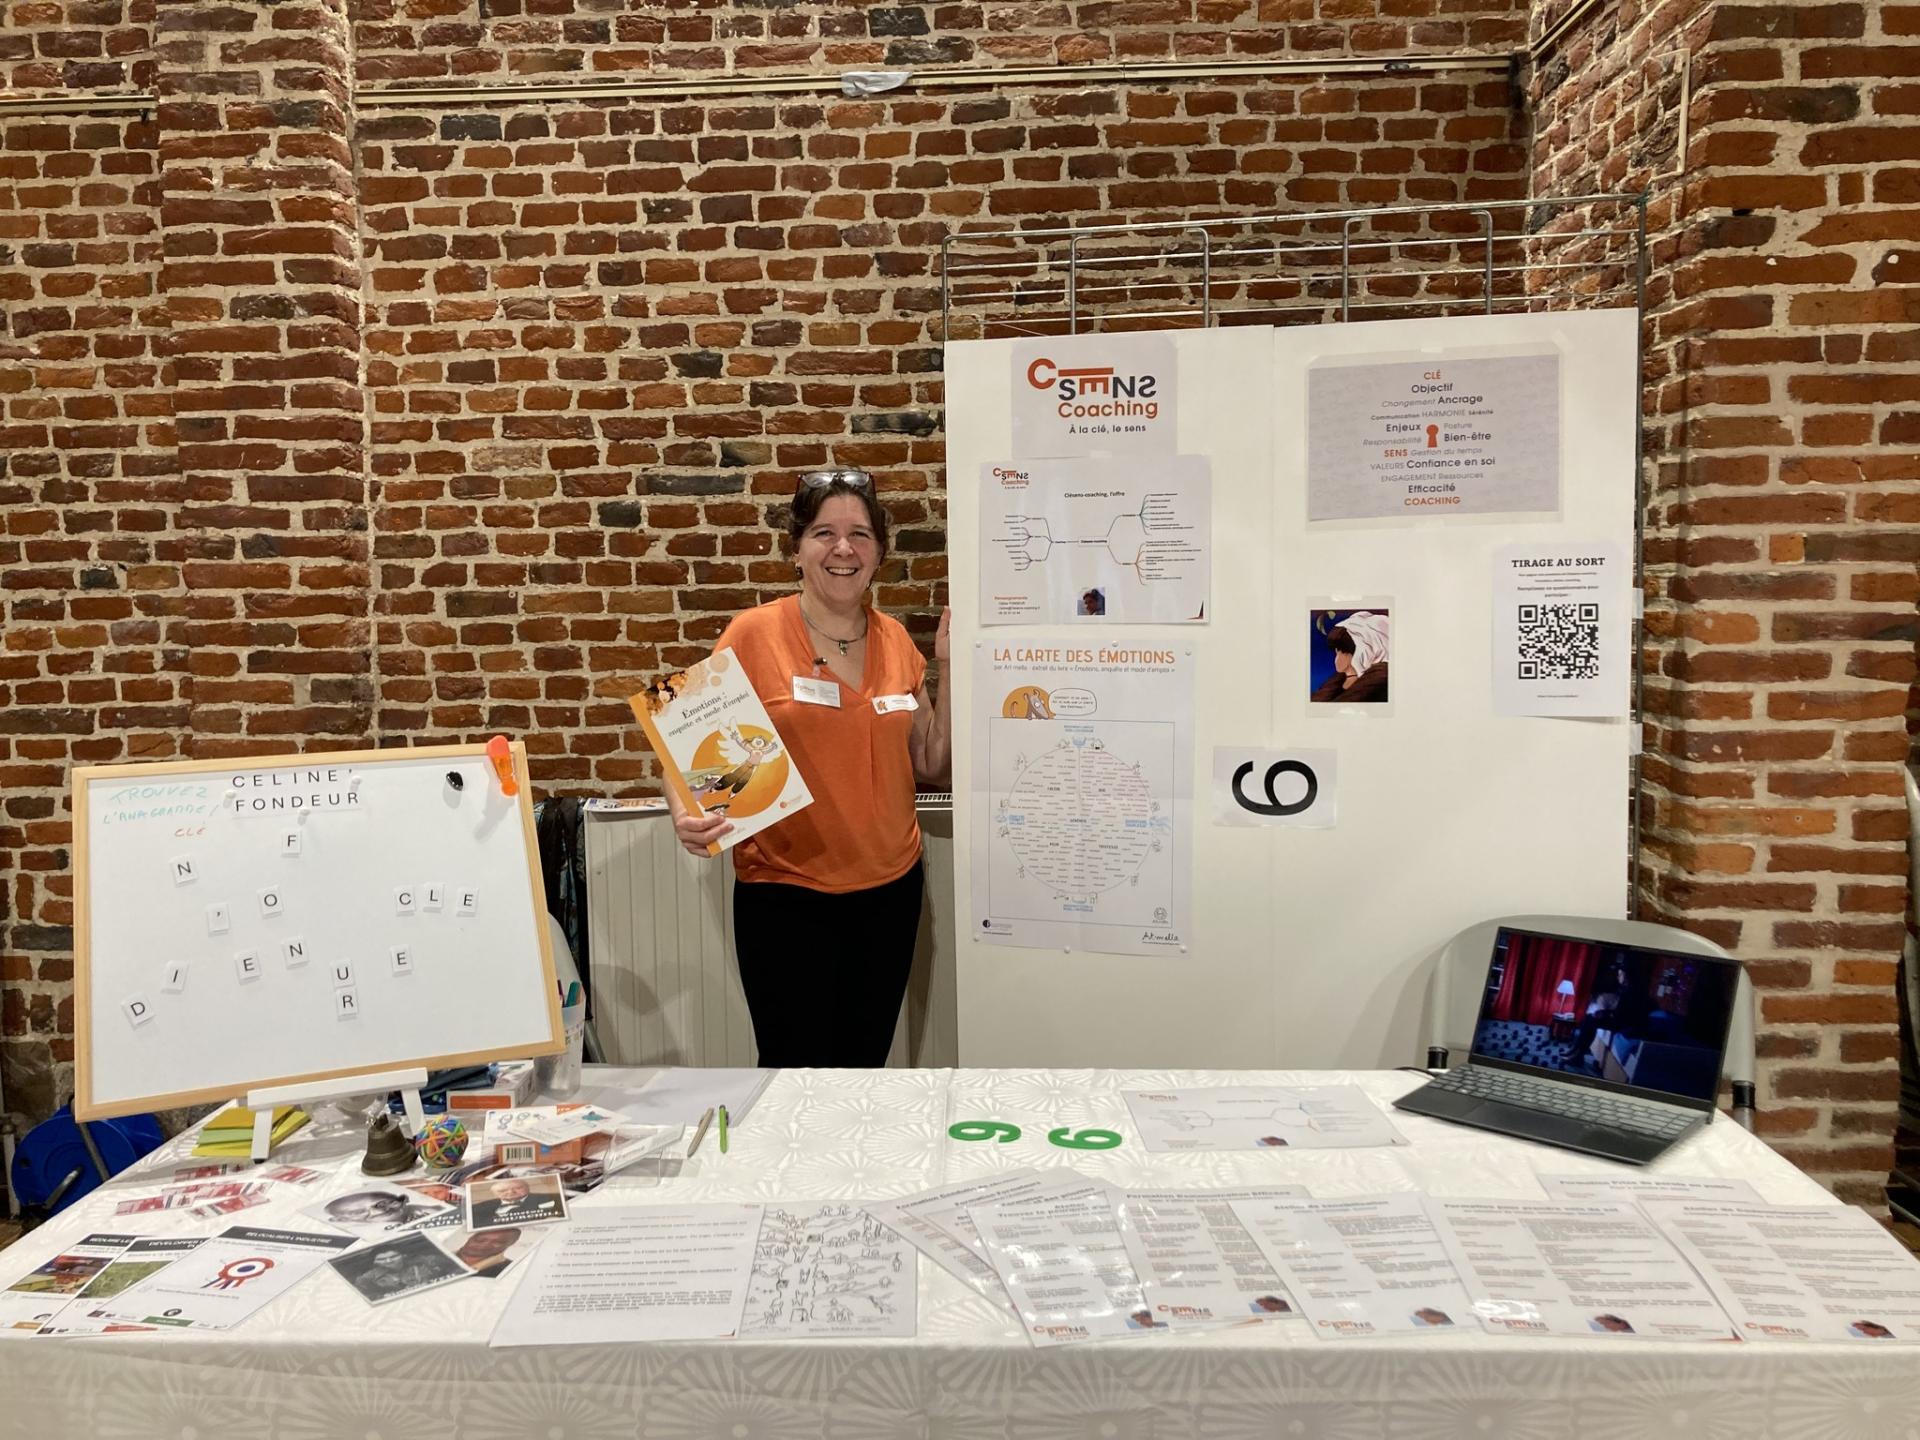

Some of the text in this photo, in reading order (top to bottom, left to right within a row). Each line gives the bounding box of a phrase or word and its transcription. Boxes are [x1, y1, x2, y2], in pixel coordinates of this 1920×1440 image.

[1423, 369, 1441, 380] CLÉ
[1411, 383, 1453, 394] Objectif
[1382, 394, 1483, 409] Changement Ancrage
[1058, 401, 1158, 419] Coaching
[1370, 412, 1420, 421] Communication
[1422, 409, 1466, 418] HARMONIE
[1069, 424, 1146, 435] À la clé, le sens
[1386, 423, 1421, 433] Enjeux
[1444, 422, 1472, 430] Posture
[1363, 436, 1422, 447] Responsabilité
[1444, 432, 1491, 442] Bien-être
[1384, 447, 1482, 458] SENS Gestion du temps
[1370, 462, 1404, 470] VALEURS
[1407, 458, 1461, 469] Confiance
[1481, 457, 1495, 466] soi
[1381, 471, 1483, 482] ENGAGEMENT Ressources
[1408, 482, 1456, 493] Efficacité
[1404, 496, 1461, 506] COACHING
[1512, 557, 1605, 568] TIRAGE AU SORT
[994, 648, 1176, 664] LA CARTE DES ÉMOTIONS
[703, 706, 721, 720] mode
[235, 793, 359, 811] FONDEUR
[287, 834, 297, 847] F
[177, 862, 192, 876] N
[289, 943, 303, 957] N
[244, 958, 255, 972] E
[397, 952, 407, 966] E
[337, 967, 349, 981] U
[342, 994, 353, 1009] R
[131, 1002, 146, 1017] D
